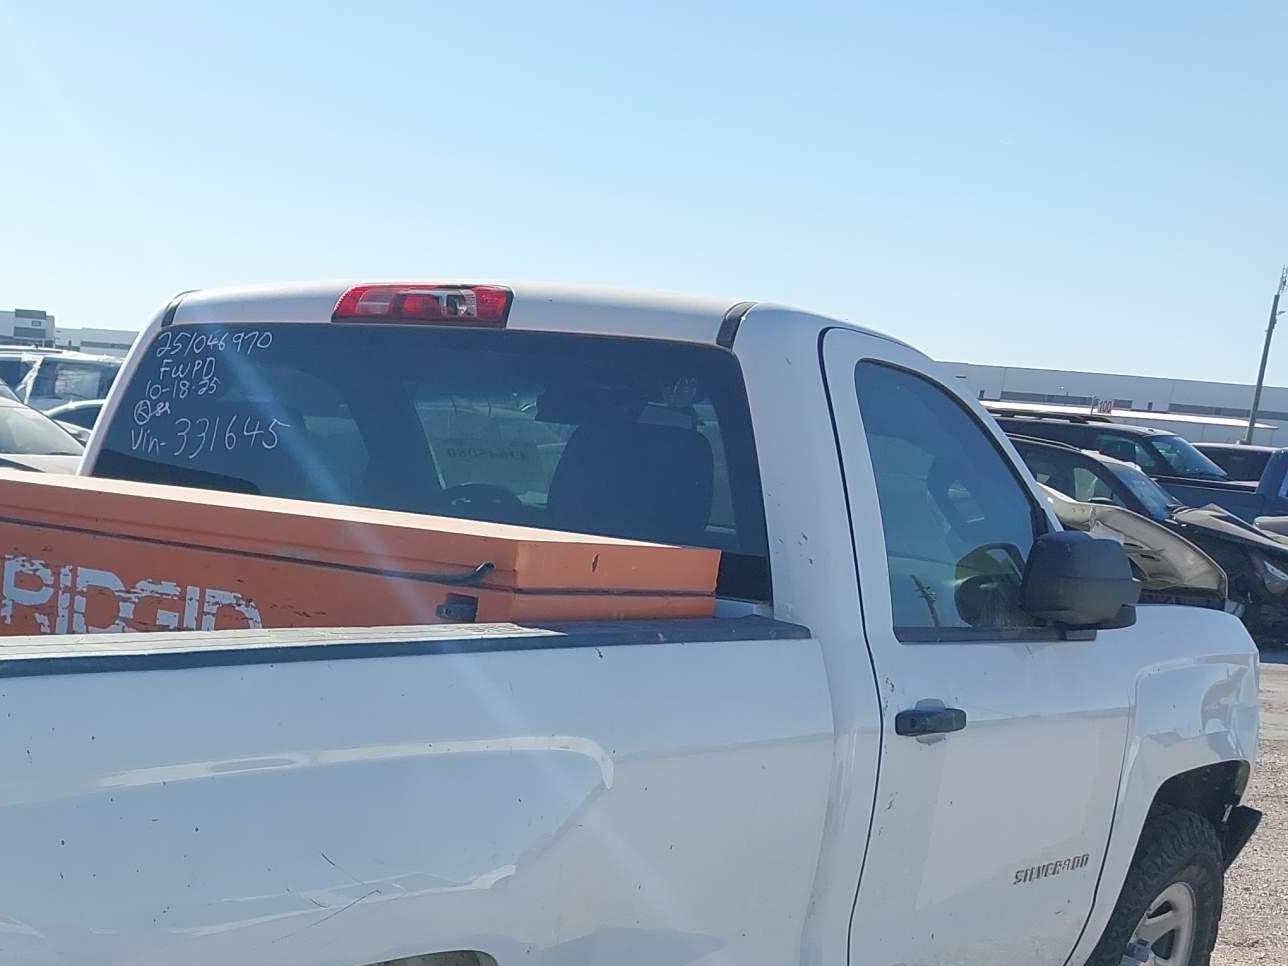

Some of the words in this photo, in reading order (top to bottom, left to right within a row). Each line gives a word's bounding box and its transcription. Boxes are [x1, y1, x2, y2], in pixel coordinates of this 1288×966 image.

[159, 356, 216, 380] FWPD
[173, 415, 291, 459] 331645
[1013, 853, 1090, 885] SILVERADO
